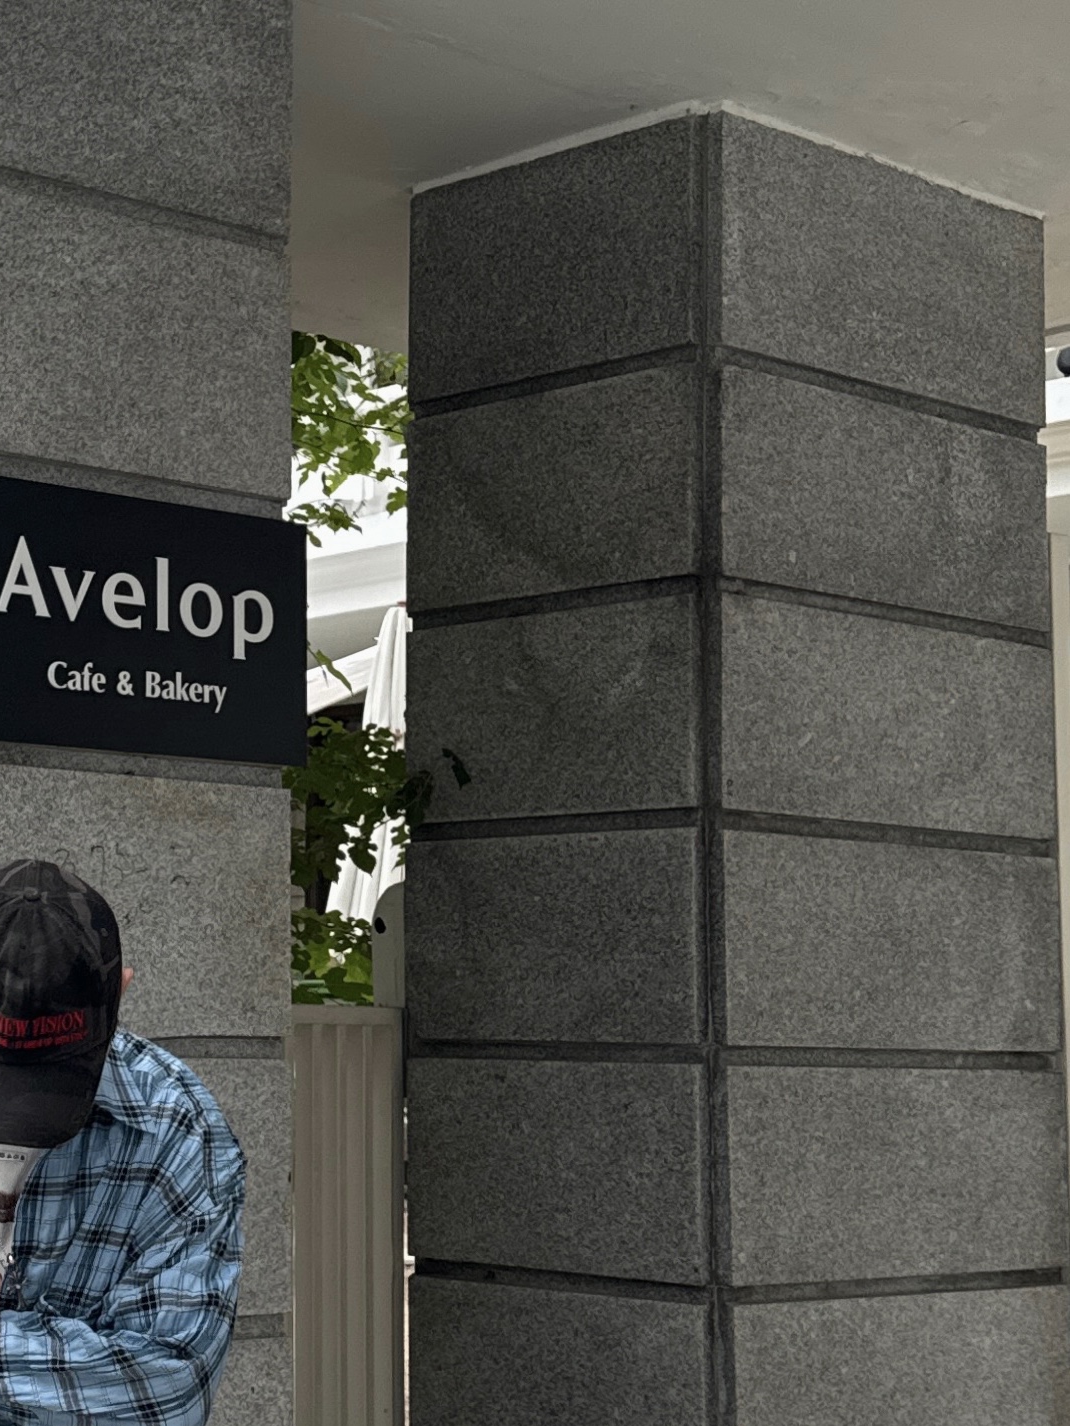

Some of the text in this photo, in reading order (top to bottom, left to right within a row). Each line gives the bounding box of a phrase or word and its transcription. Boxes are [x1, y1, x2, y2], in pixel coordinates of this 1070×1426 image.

[47, 661, 227, 714] Cafe & Bakery
[32, 1009, 85, 1037] VISION
